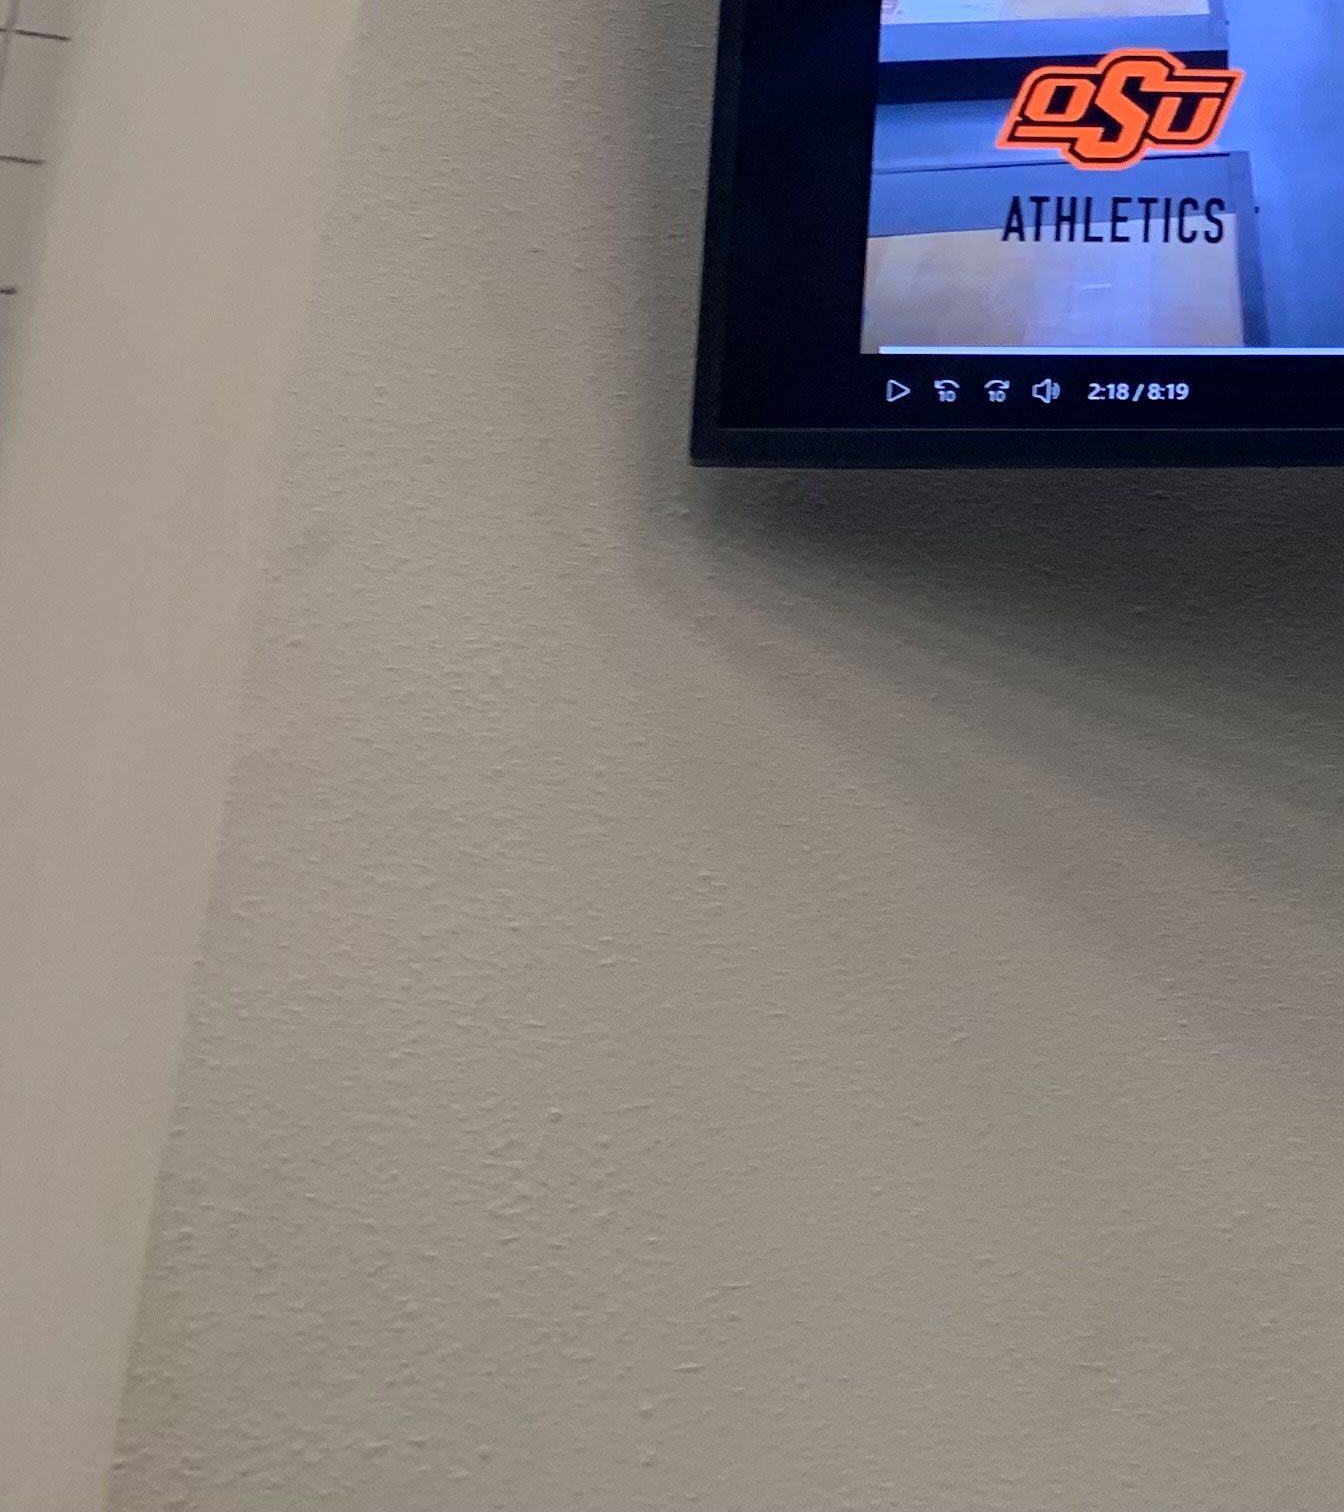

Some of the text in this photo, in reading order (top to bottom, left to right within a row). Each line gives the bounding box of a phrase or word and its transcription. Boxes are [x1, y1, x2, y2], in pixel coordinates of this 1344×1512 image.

[996, 48, 1245, 170] OSU
[1002, 196, 1225, 244] ATHLETICS
[1087, 382, 1130, 400] 2:18
[1147, 382, 1190, 400] 8:19
